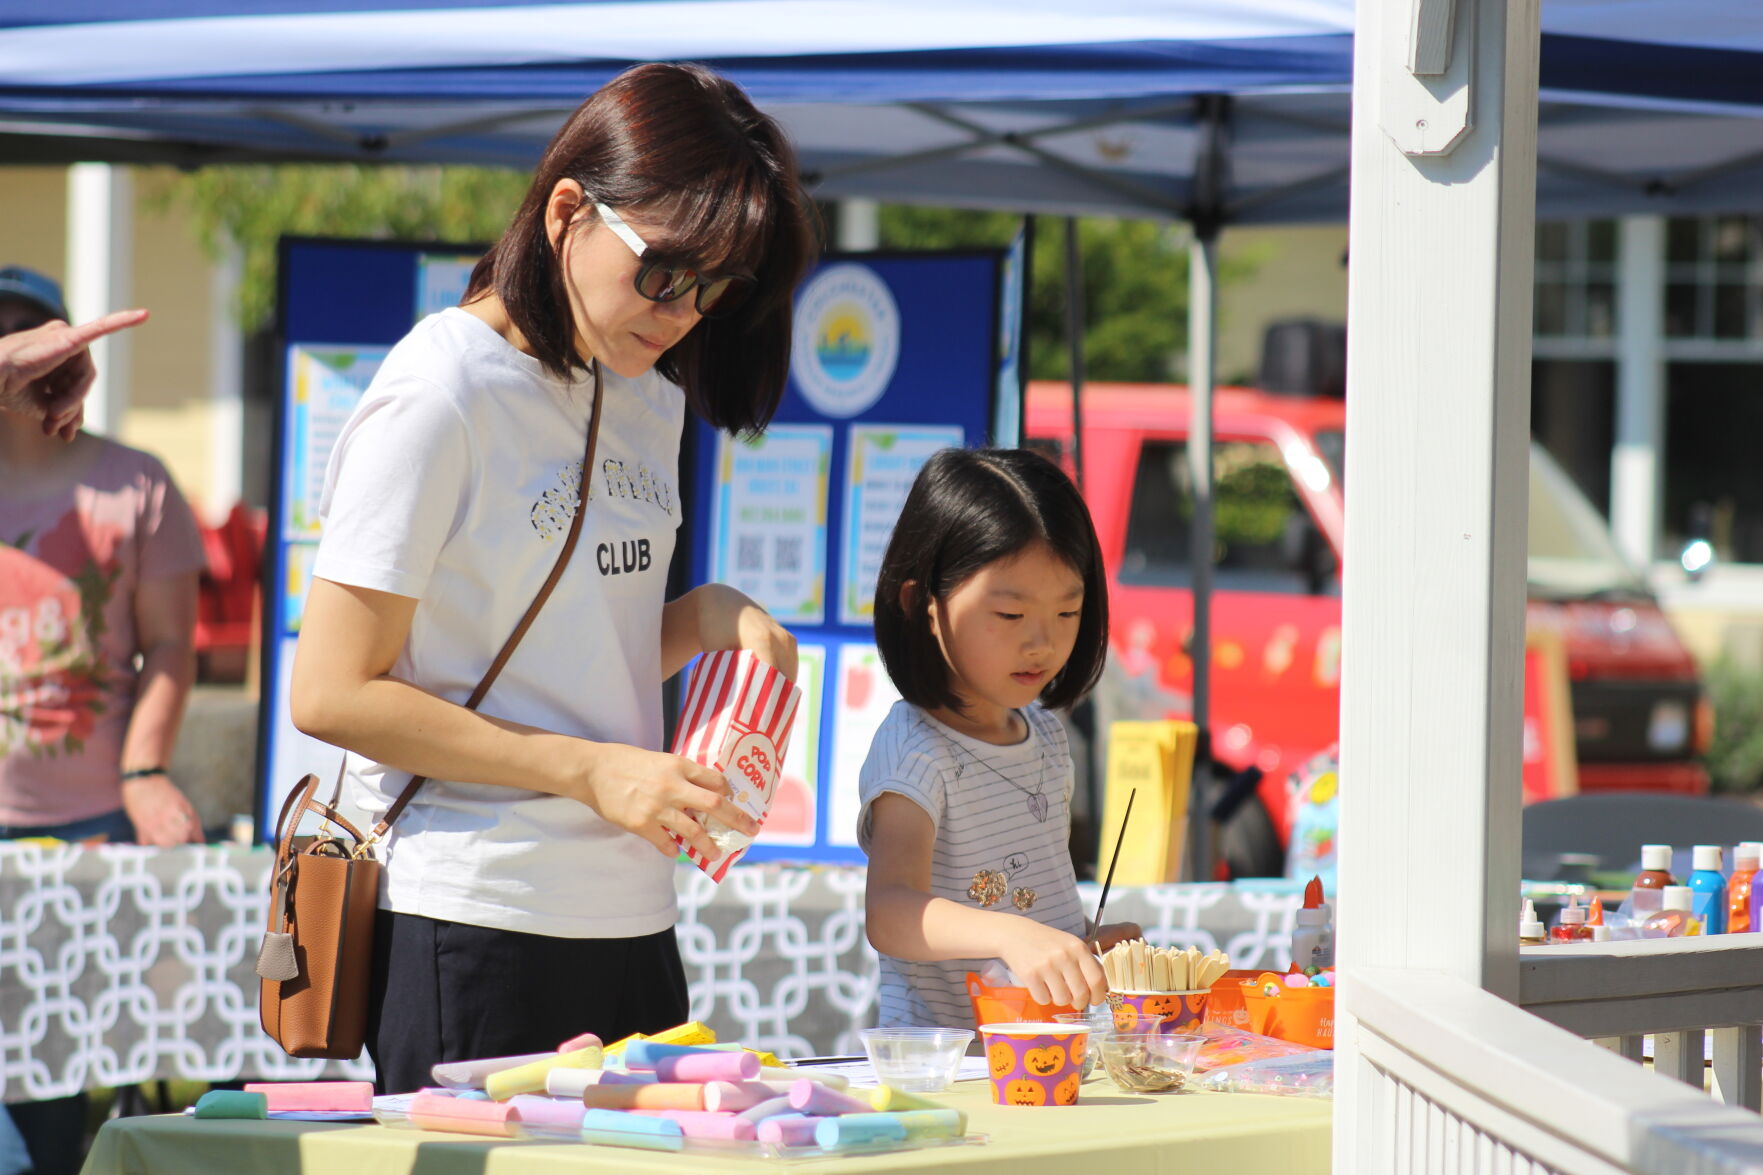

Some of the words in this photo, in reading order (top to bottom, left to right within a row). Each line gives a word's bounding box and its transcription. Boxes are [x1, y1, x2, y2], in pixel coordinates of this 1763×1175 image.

[597, 538, 652, 576] CLUB
[736, 755, 767, 792] CORN
[752, 746, 771, 772] POP
